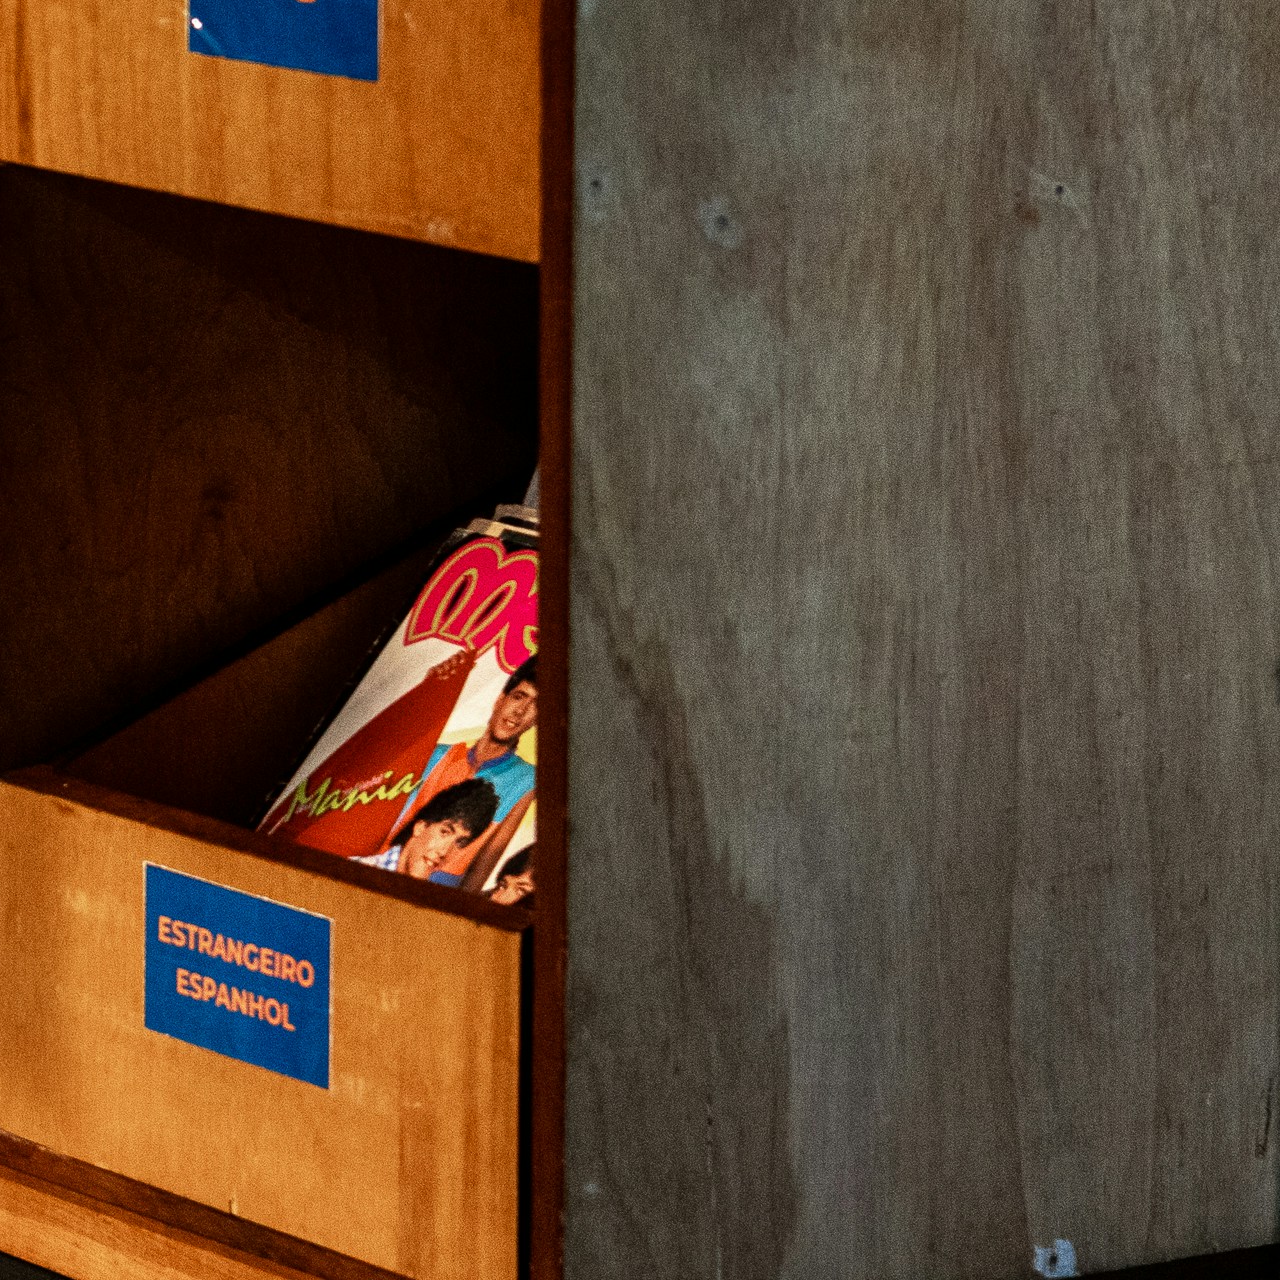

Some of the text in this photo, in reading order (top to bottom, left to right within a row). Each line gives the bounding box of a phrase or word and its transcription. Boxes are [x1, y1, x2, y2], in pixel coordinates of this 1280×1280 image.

[285, 771, 424, 821] Mania
[157, 915, 315, 988] ESTRANGEIRO
[176, 968, 296, 1032] ESPANHOL
